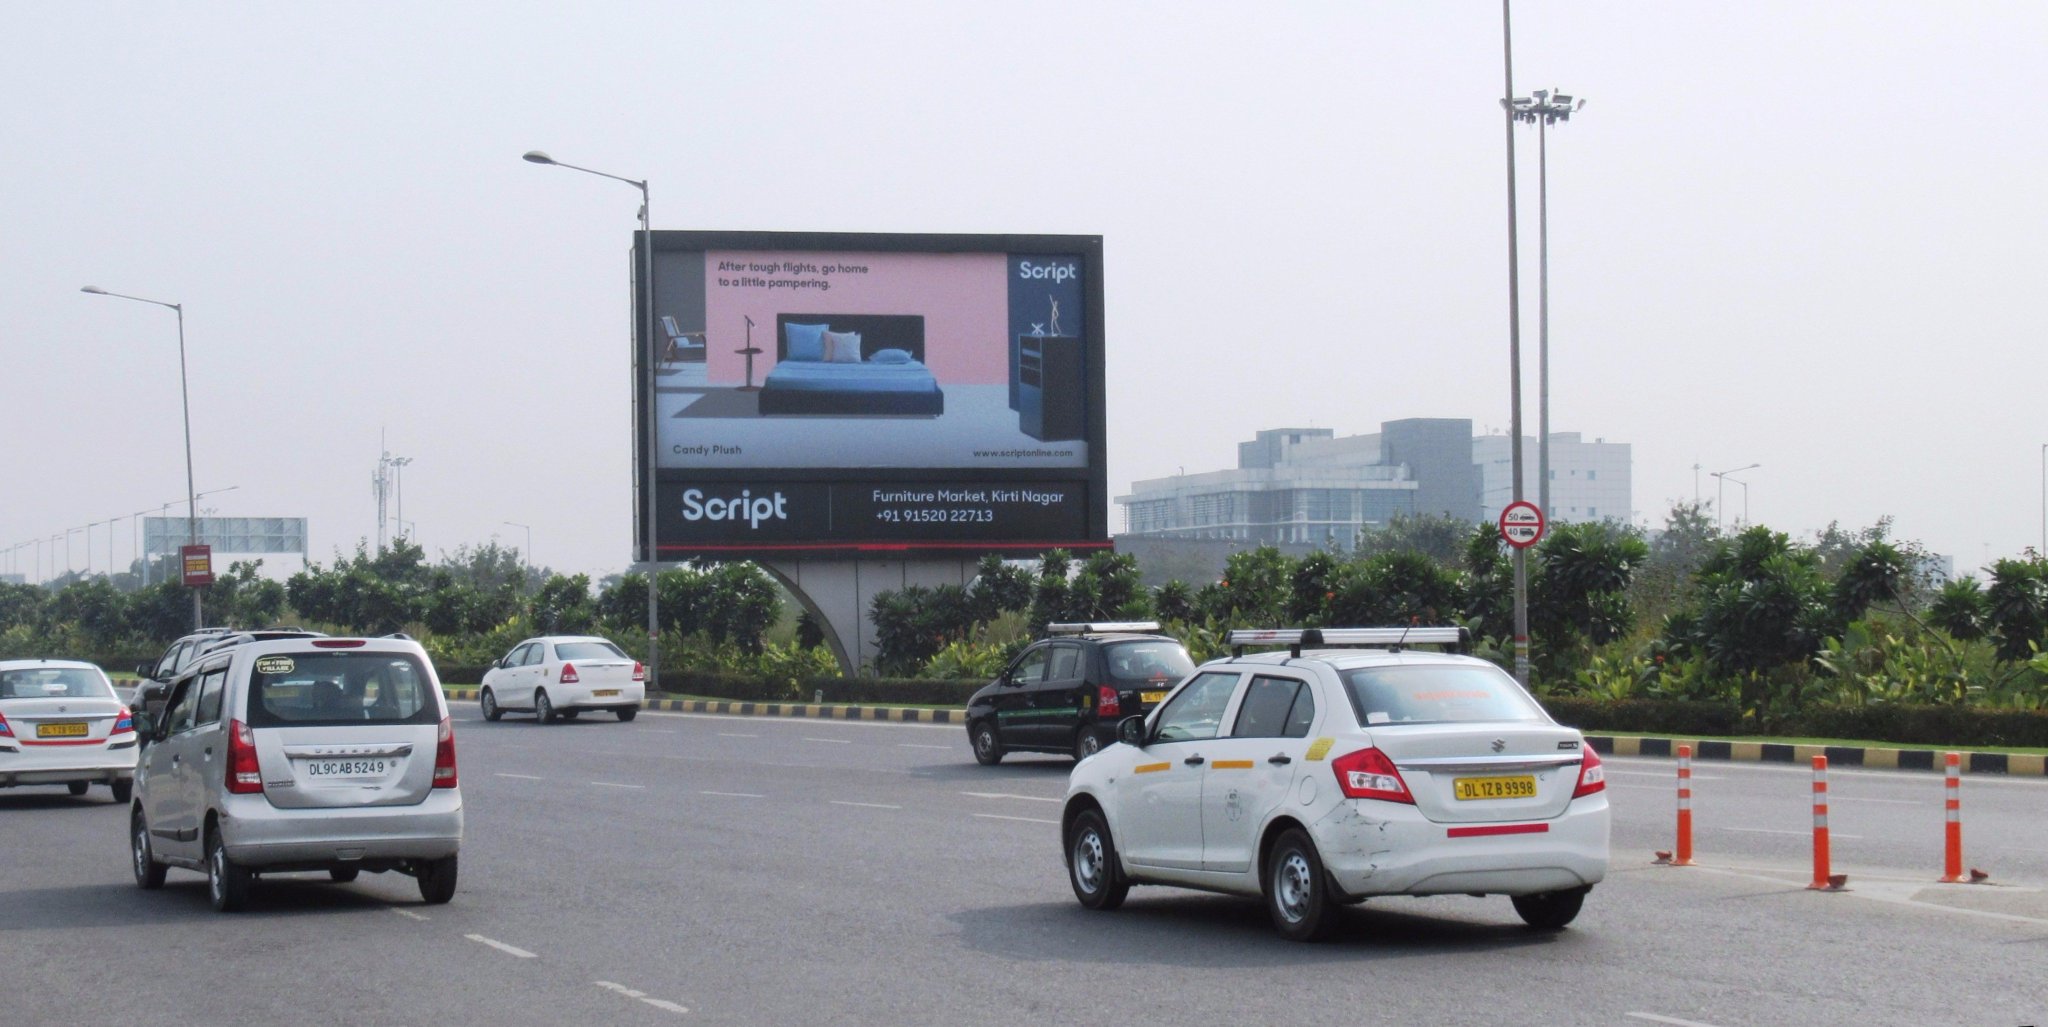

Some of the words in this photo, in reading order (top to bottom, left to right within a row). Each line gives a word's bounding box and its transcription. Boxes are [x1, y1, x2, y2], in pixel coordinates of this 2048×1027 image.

[718, 261, 746, 273] After
[749, 262, 781, 275] tough
[783, 262, 819, 276] flights,
[821, 266, 836, 276] go
[838, 264, 869, 275] home
[1019, 262, 1076, 283] Script
[718, 277, 729, 287] to
[732, 280, 740, 288] a
[742, 277, 766, 289] little
[768, 278, 832, 291] pampering.
[673, 444, 710, 457] Candy
[713, 444, 742, 455] Plush
[973, 448, 1073, 459] www.scriptonline.com
[873, 490, 935, 503] Furniture
[937, 490, 989, 504] Market,
[992, 490, 1019, 503] Kirti
[1022, 491, 1064, 506] Nagar
[682, 488, 787, 530] Script
[876, 510, 900, 522] +91
[904, 510, 947, 522] 91520
[950, 510, 993, 522] 22713
[1508, 513, 1519, 521] 50
[1507, 528, 1518, 536] 40
[1505, 781, 1534, 795] 9998
